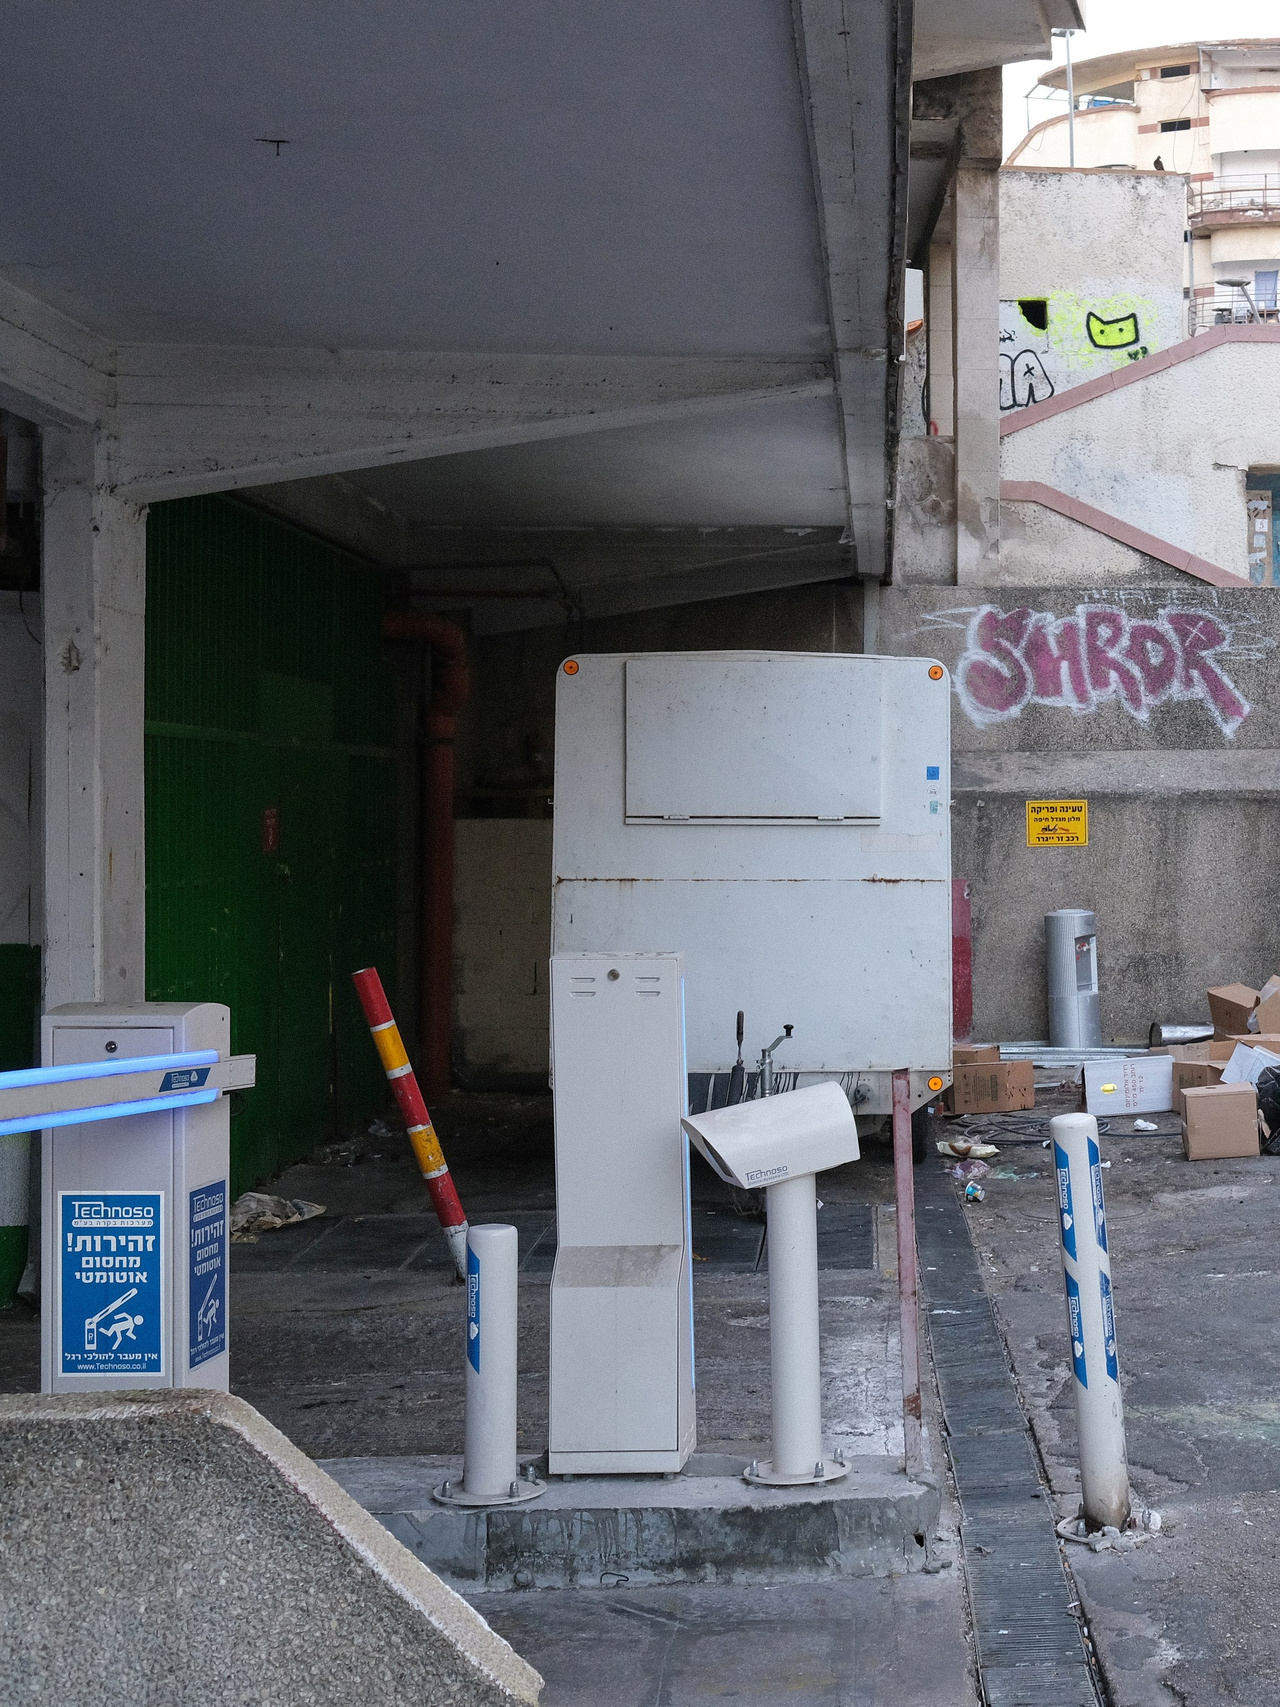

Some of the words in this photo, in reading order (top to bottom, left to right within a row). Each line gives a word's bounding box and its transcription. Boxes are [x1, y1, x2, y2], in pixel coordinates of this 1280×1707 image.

[745, 1165, 788, 1182] Technoso
[1060, 1167, 1069, 1210] Technoso
[72, 1202, 154, 1218] Technoso
[67, 1232, 156, 1252] זהירות!
[82, 1256, 141, 1268] מחסום
[74, 1272, 148, 1283] אוטומטי
[470, 1273, 478, 1318] Technoso
[1070, 1295, 1080, 1337] Technoso
[64, 1352, 82, 1360] רגל
[84, 1352, 114, 1360] להולכי
[144, 1353, 158, 1361] אין
